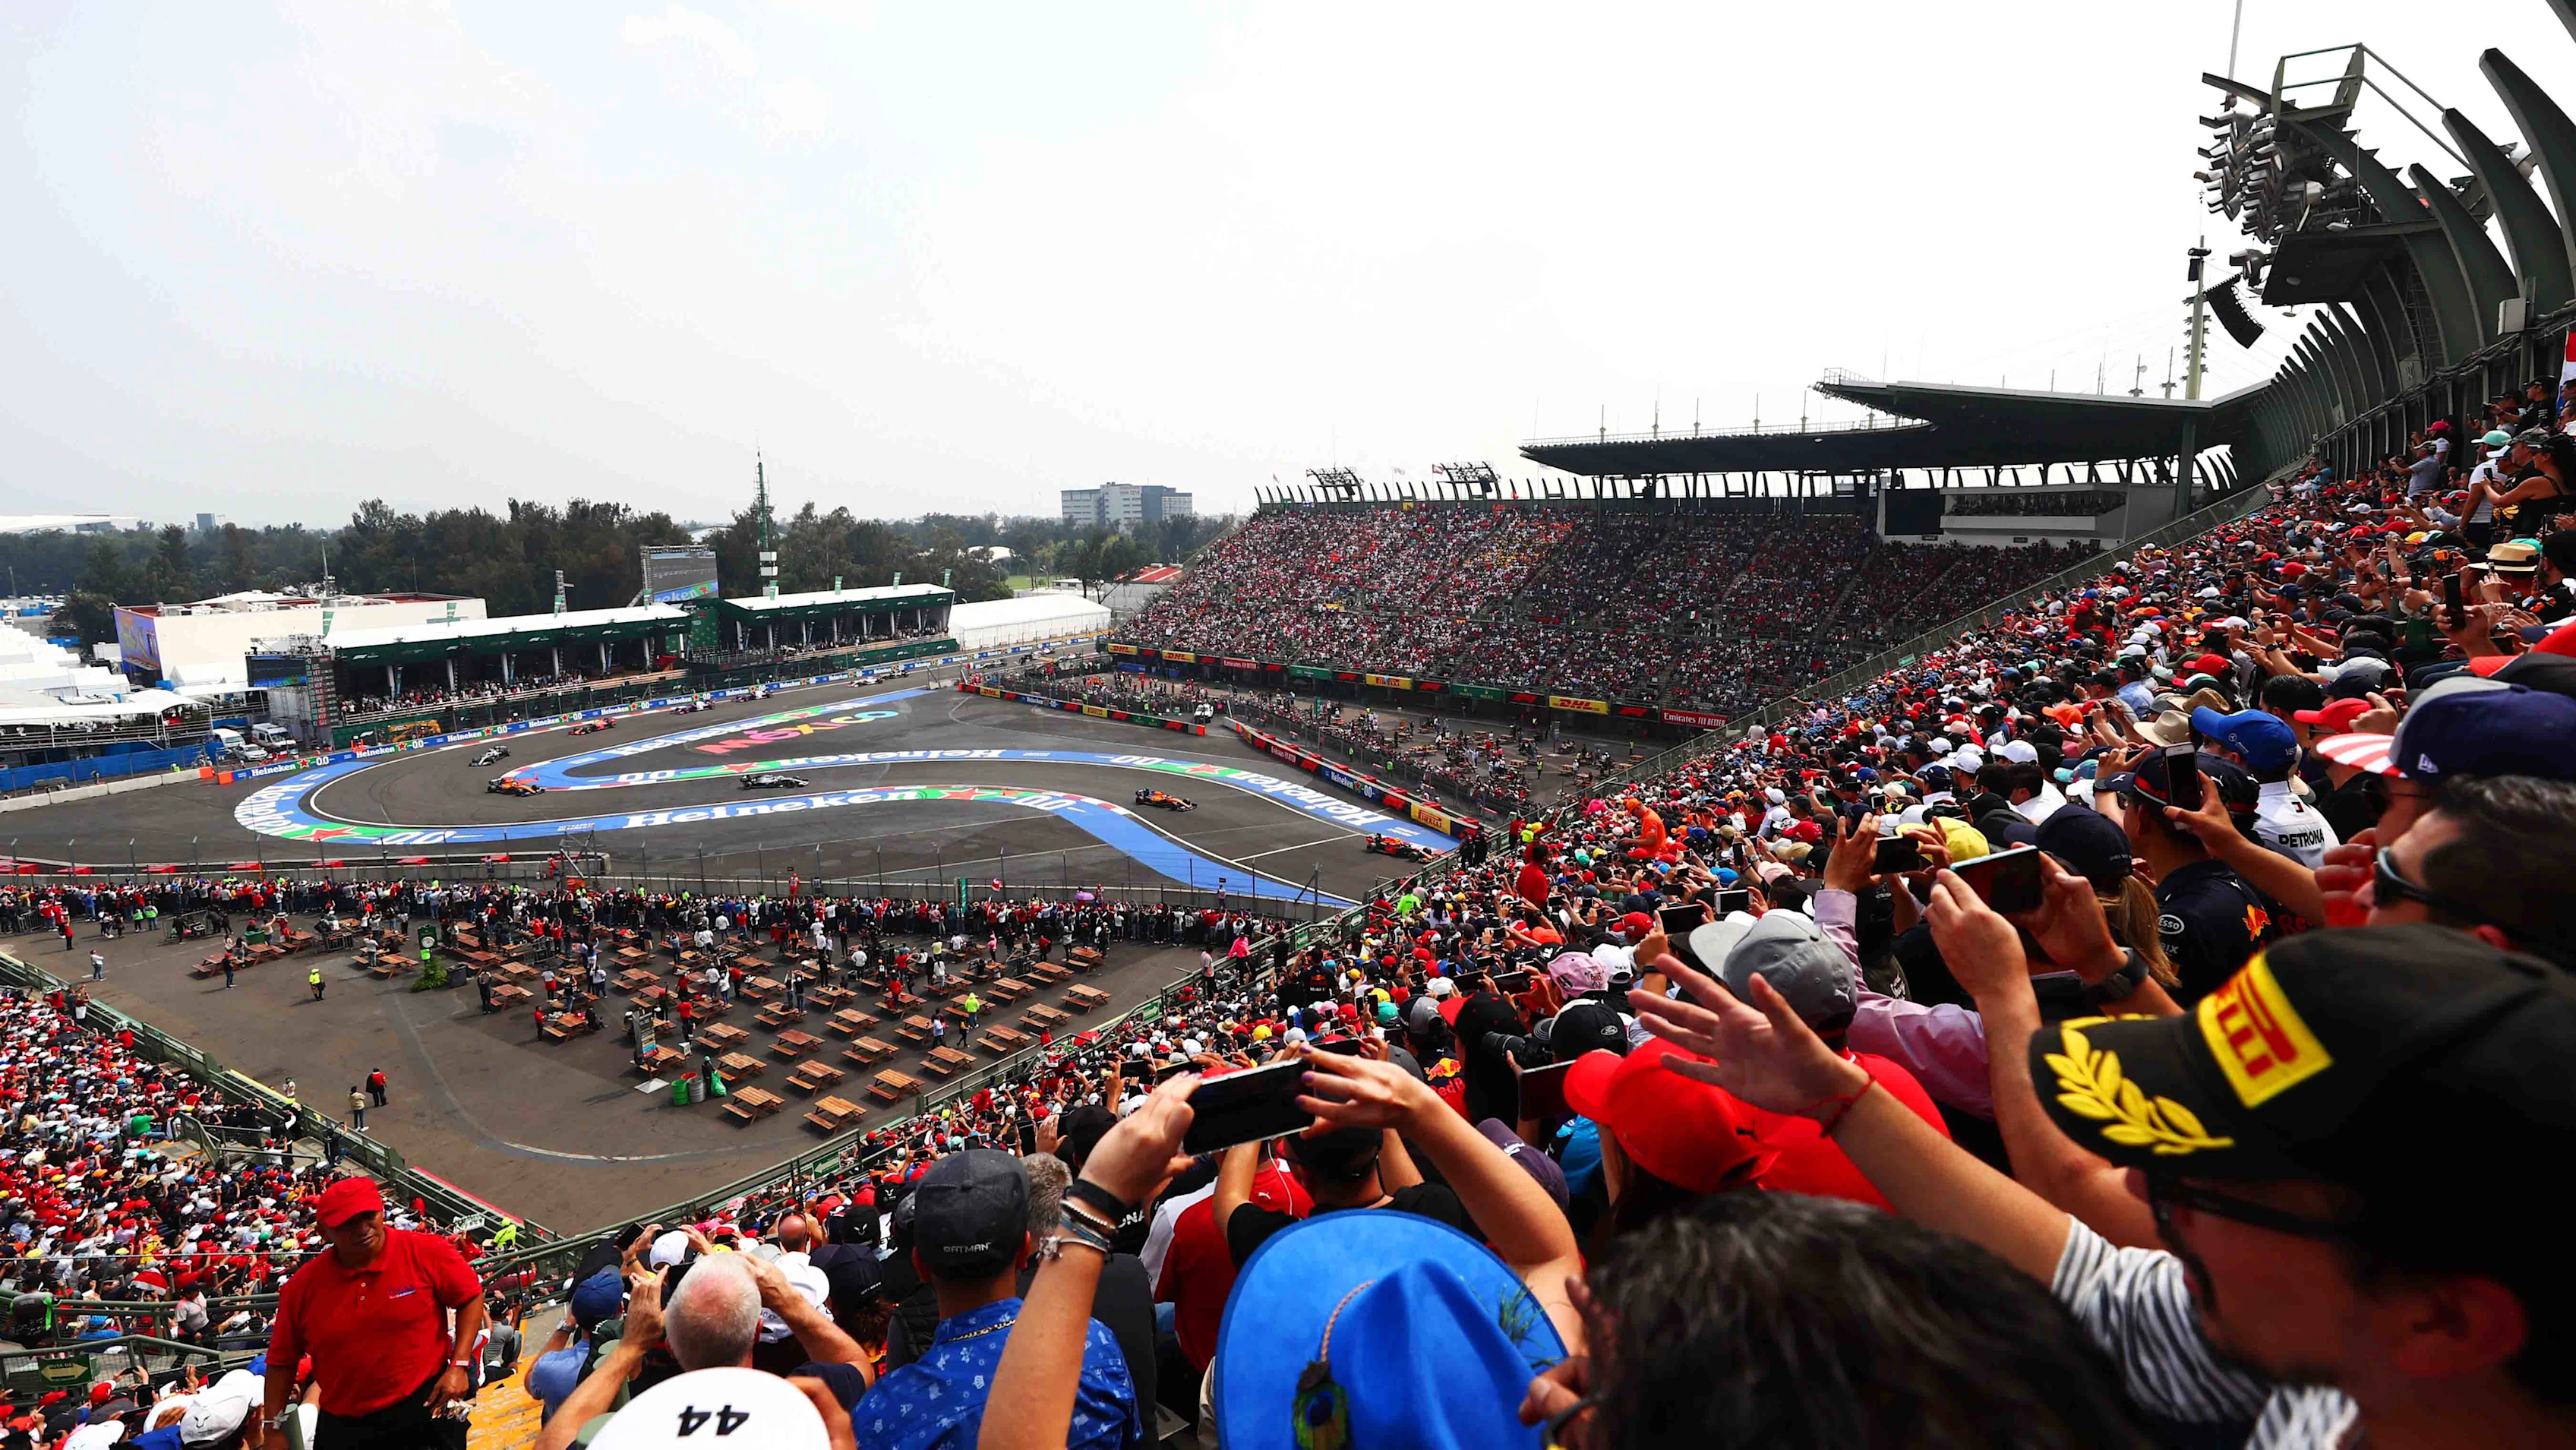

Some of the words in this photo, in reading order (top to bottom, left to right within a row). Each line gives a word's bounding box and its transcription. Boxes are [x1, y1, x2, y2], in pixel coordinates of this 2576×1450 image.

[601, 706, 629, 715] Heineken
[1558, 699, 1593, 710] DHL
[529, 717, 560, 728] Heineken
[1663, 712, 1697, 724] Emirates
[1697, 716, 1707, 725] FLY
[1707, 718, 1725, 728] BETTER
[447, 731, 482, 743] Heineken
[356, 746, 395, 759] Heineken
[779, 748, 1006, 768] Heineken
[251, 763, 296, 778] Heineken
[1331, 771, 1353, 790] Heineken
[1232, 770, 1394, 826] Heineken
[623, 788, 917, 829] Heineken
[1419, 809, 1442, 828] PIRELLI
[942, 1242, 990, 1253] BATMAN
[677, 1404, 750, 1437] 44
